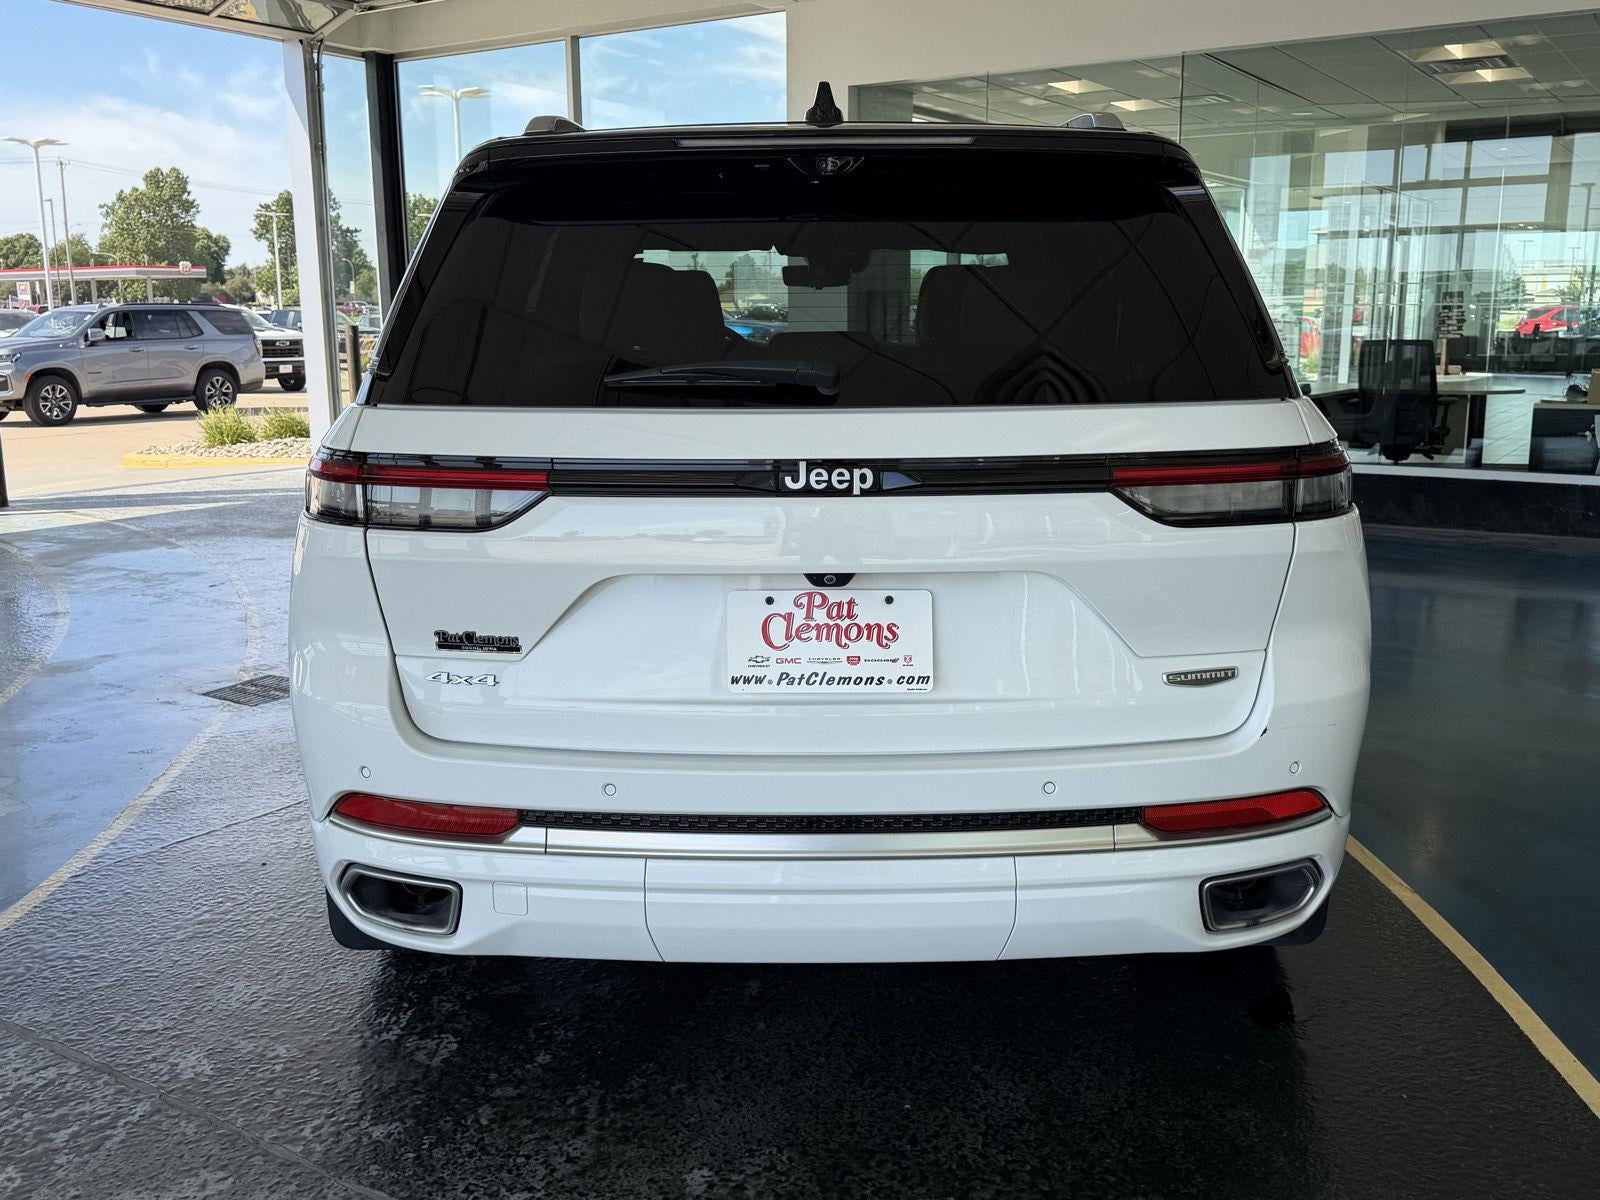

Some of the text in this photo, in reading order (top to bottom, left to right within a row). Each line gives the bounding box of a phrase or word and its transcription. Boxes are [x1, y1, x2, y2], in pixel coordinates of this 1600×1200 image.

[784, 461, 874, 495] Jeep
[793, 591, 858, 622] Pat
[434, 630, 519, 647] Pat Clemons
[761, 611, 899, 651] Clemons
[775, 657, 802, 665] GMC
[425, 671, 499, 687] 4x4
[1168, 670, 1235, 682] SUMMIT
